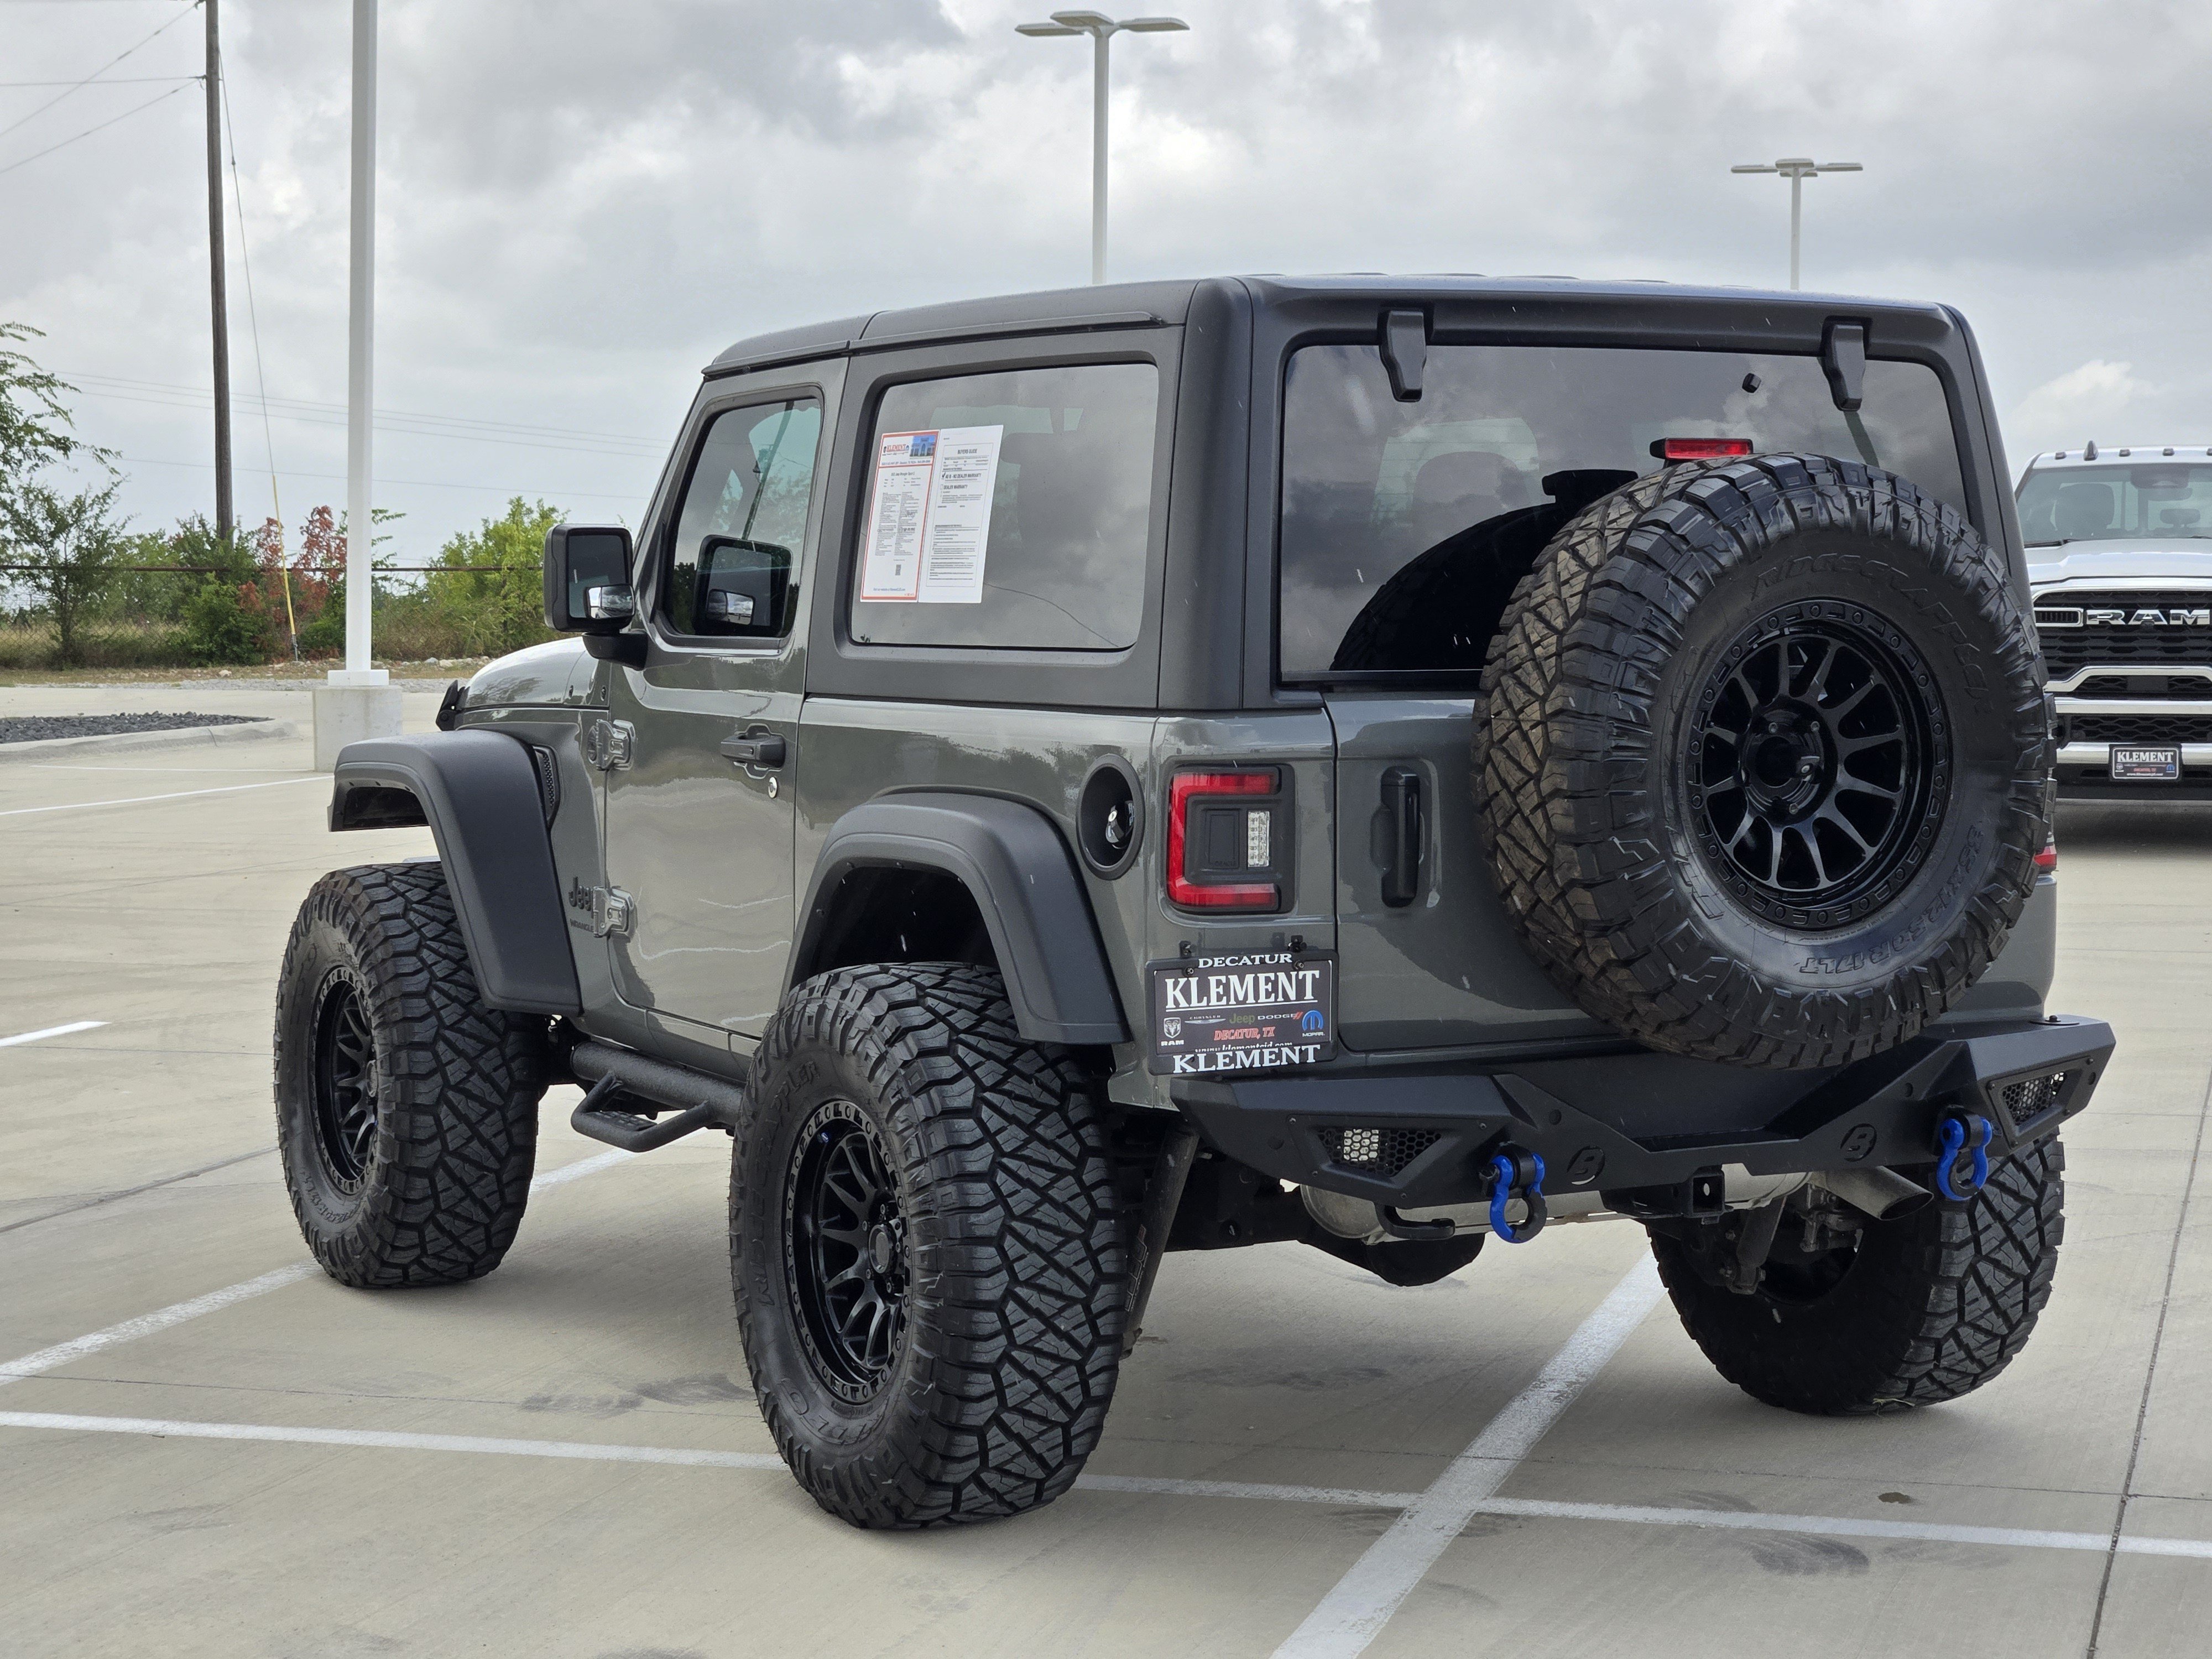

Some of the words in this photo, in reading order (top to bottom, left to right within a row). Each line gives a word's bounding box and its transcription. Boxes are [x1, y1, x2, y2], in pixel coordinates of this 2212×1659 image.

[2086, 609, 2210, 625] RAM
[2117, 752, 2174, 762] KLEMENT
[1198, 953, 1293, 968] DECATUR
[1165, 970, 1320, 1009] KLEMENT
[1229, 1013, 1255, 1025] Jeep
[1214, 1027, 1260, 1041] DECATUR,
[1262, 1026, 1276, 1037] TX
[1173, 1044, 1321, 1074] KLEMENT
